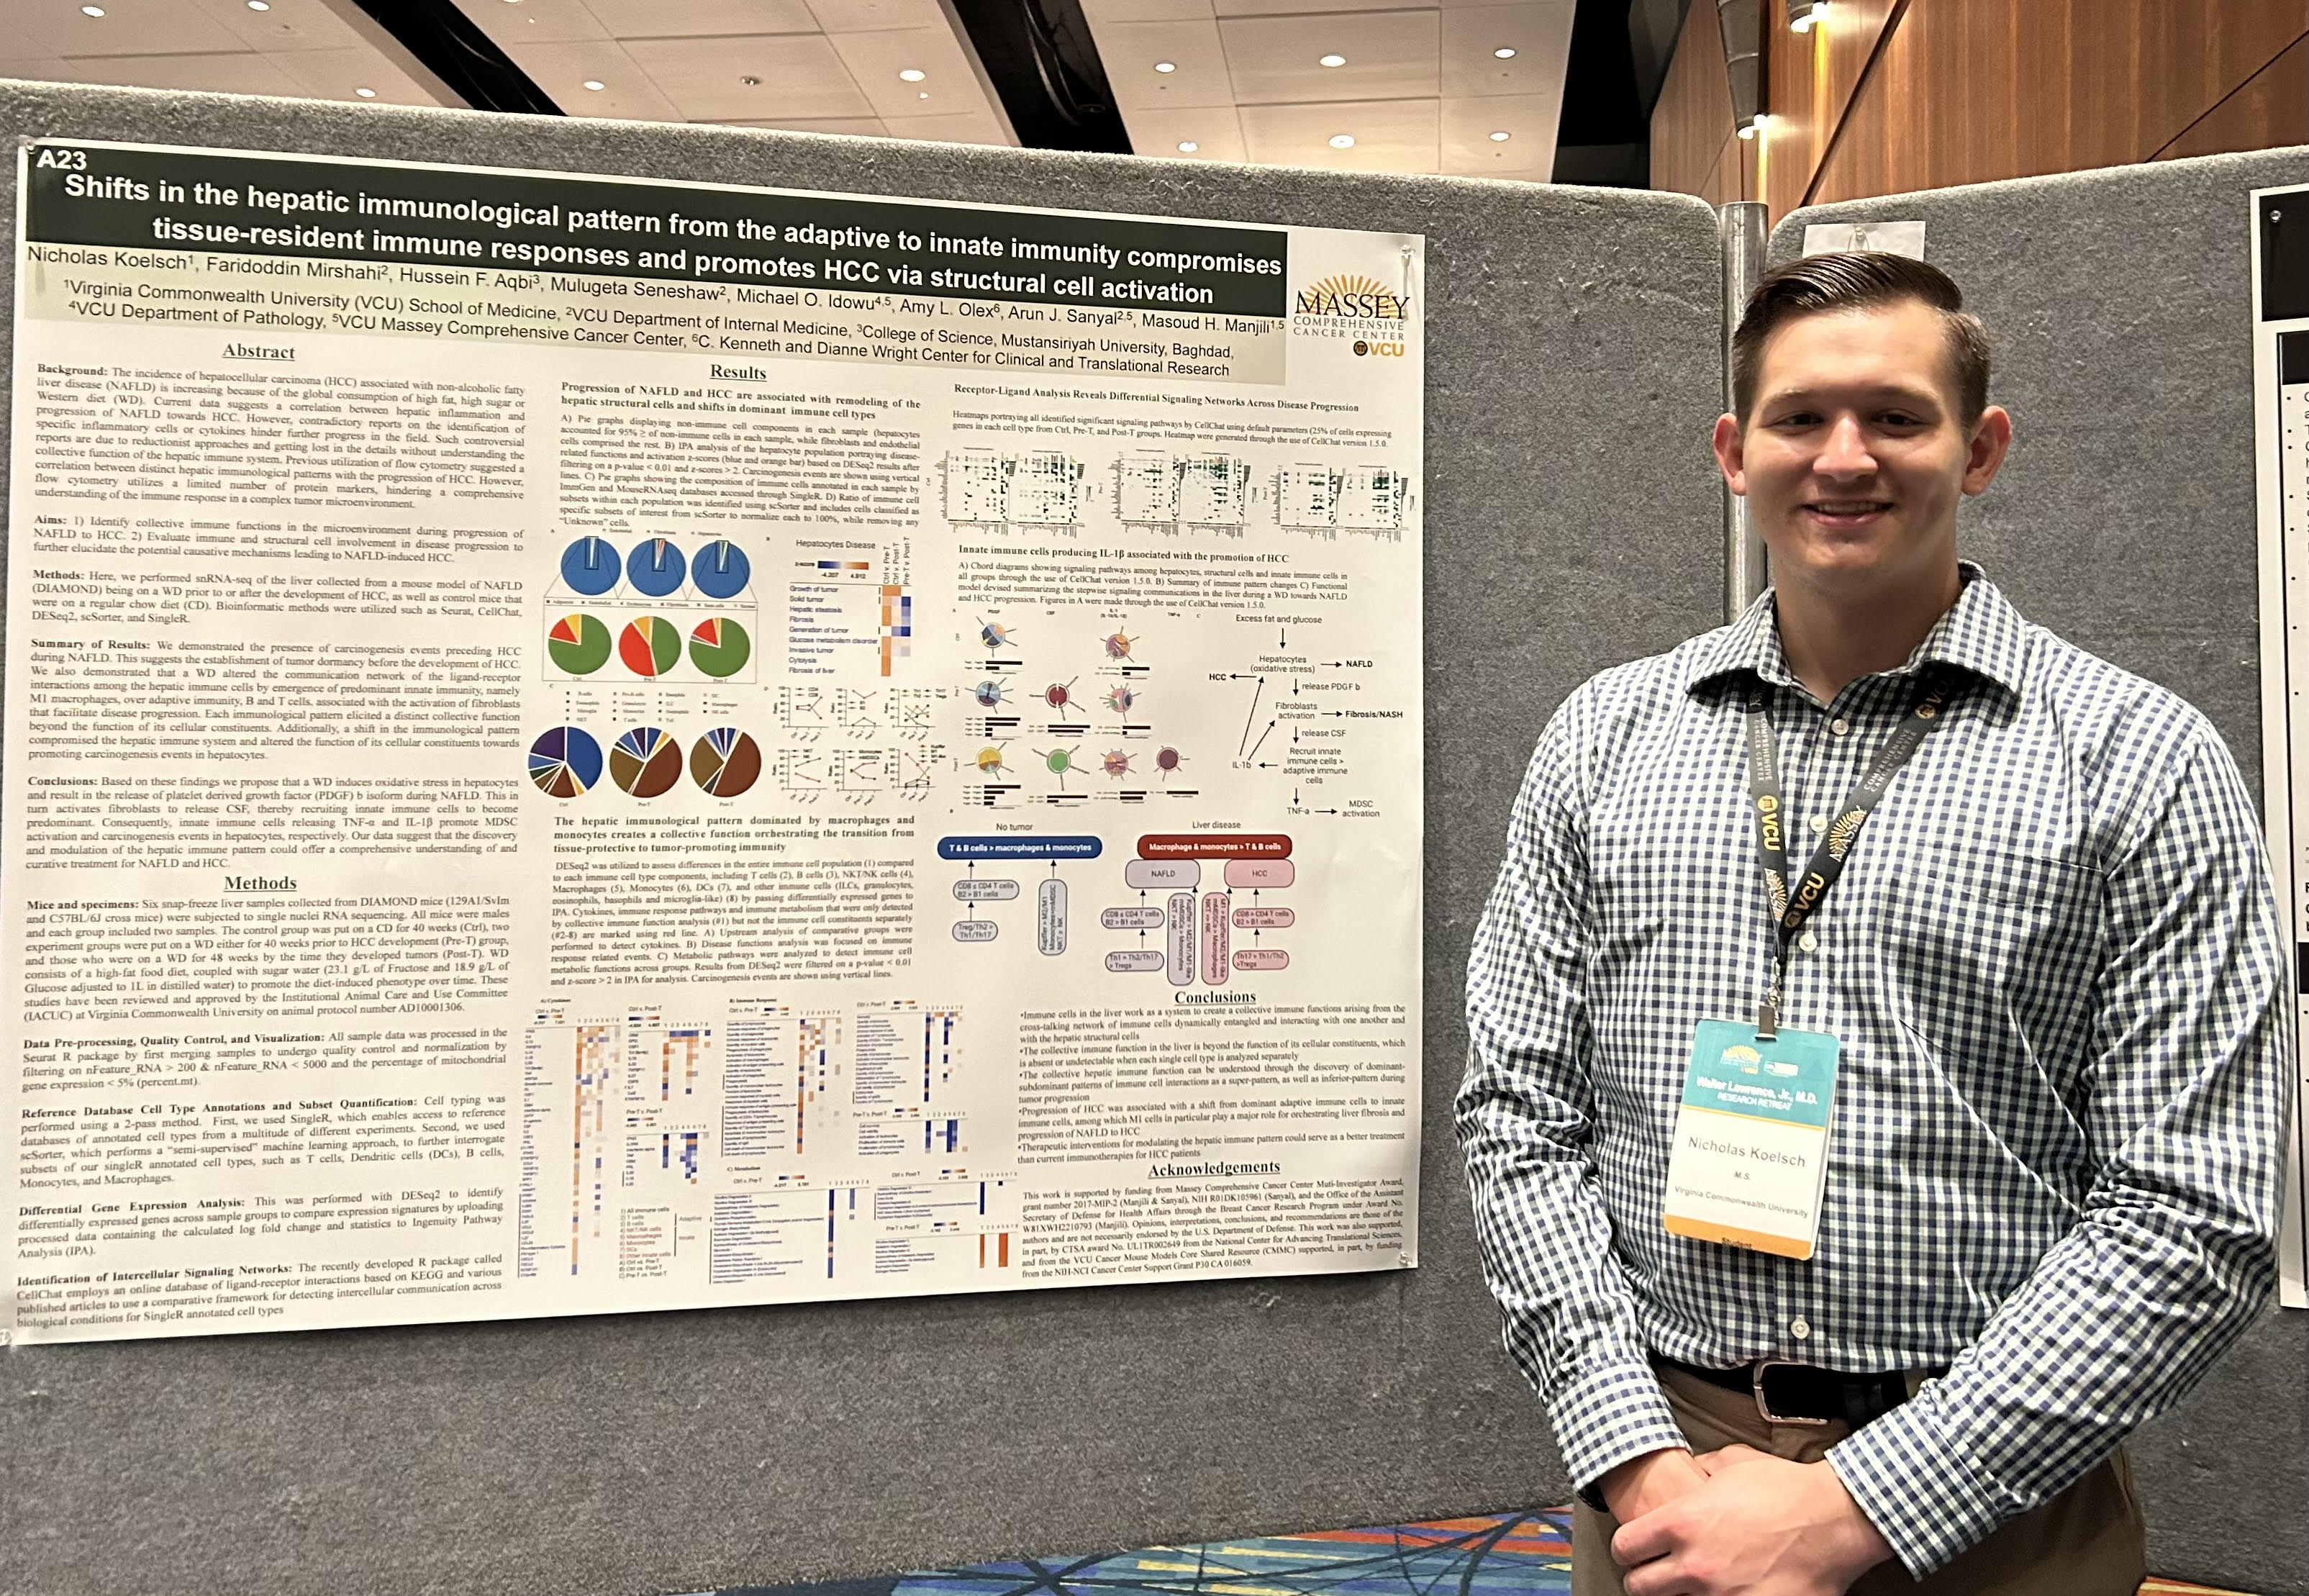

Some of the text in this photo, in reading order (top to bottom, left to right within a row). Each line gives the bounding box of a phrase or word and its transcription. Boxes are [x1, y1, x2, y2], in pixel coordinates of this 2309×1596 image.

[37, 149, 87, 171] A23
[65, 173, 1281, 275] Shifts in the hepatic immunological pattern from the adaptive to innate immunity compromises
[153, 217, 1212, 304] tissue-resident immune responses and promotes HCC via structural cell activation
[29, 246, 107, 266] Nicholas
[207, 256, 299, 276] Faridoddin
[401, 267, 468, 285] Hussein
[476, 272, 489, 286] F.
[551, 276, 627, 296] Mulugeta
[738, 288, 798, 305] Michael
[804, 292, 822, 307] O.
[900, 299, 934, 316] Amy
[940, 302, 953, 316] L.
[1009, 307, 1044, 320] Arun
[1049, 308, 1062, 322] J.
[1142, 314, 1199, 330] Masoud
[1205, 317, 1220, 330] H.
[1294, 291, 1410, 319] MASSEY
[138, 284, 264, 304] Commonwealth
[272, 291, 349, 311] University
[355, 295, 403, 314] (VCU)
[409, 299, 462, 314] School
[468, 302, 483, 315] of
[488, 302, 560, 322] Medicine,
[614, 310, 701, 328] Department
[706, 316, 720, 329] of
[725, 317, 778, 332] Internal
[784, 320, 851, 338] Medicine,
[921, 329, 934, 342] of
[938, 329, 997, 348] Science,
[1002, 333, 1094, 353] Mustansiriyah
[1101, 338, 1167, 357] University,
[1173, 343, 1233, 360] Baghdad,
[1293, 316, 1405, 331] COMPREHENSIVE
[122, 304, 218, 322] Department
[223, 309, 238, 322] of
[244, 309, 326, 330] Pathology,
[382, 317, 443, 337] Massey
[448, 320, 568, 340] Comprehensive
[574, 327, 629, 343] Cancer
[634, 331, 686, 348] Center,
[720, 336, 780, 352] Kenneth
[786, 340, 812, 353] and
[818, 341, 867, 356] Dianne
[872, 345, 917, 362] Wright
[922, 348, 968, 363] Center
[973, 350, 991, 364] for
[995, 352, 1043, 367] Clinical
[1049, 352, 1074, 368] and
[1078, 356, 1162, 373] Translational
[1168, 358, 1229, 376] Research
[1293, 327, 1405, 340] CANCER CENTER
[222, 344, 296, 360] Abstract
[1369, 343, 1405, 357] VCU
[37, 364, 108, 376] Background:
[709, 363, 767, 381] Results
[955, 384, 1030, 396] Receptor-Ligand
[1033, 389, 1070, 399] Analysis
[1074, 390, 1106, 399] Reveals
[1110, 391, 1159, 402] Differential
[1162, 394, 1202, 406] Signaling
[1205, 396, 1245, 406] Networks
[1278, 400, 1307, 409] Disease
[1311, 402, 1358, 412] Progression
[35, 515, 67, 525] Aims:
[33, 570, 84, 580] Methods:
[1293, 616, 1323, 625] glucose
[32, 639, 150, 650] Summary of Results:
[1259, 656, 1307, 664] Hepatocytes
[1289, 665, 1315, 674] stress)
[1345, 710, 1403, 719] Fibrosis/NASH
[28, 776, 98, 786] Conclusions:
[1761, 812, 1781, 851] VCU
[1829, 805, 1867, 863] MASSEY
[224, 876, 297, 891] Methods
[1794, 871, 1825, 910] VCU
[27, 901, 54, 910] Mice
[81, 901, 139, 911] specimens:
[1174, 990, 1256, 1005] Conclusions
[1689, 1136, 1806, 1167] Nicholas Koelsch
[1148, 1160, 1281, 1178] Acknowledgements
[1674, 1185, 1808, 1219] Virginia Commonwealth University
[1721, 1237, 1752, 1250] Student
